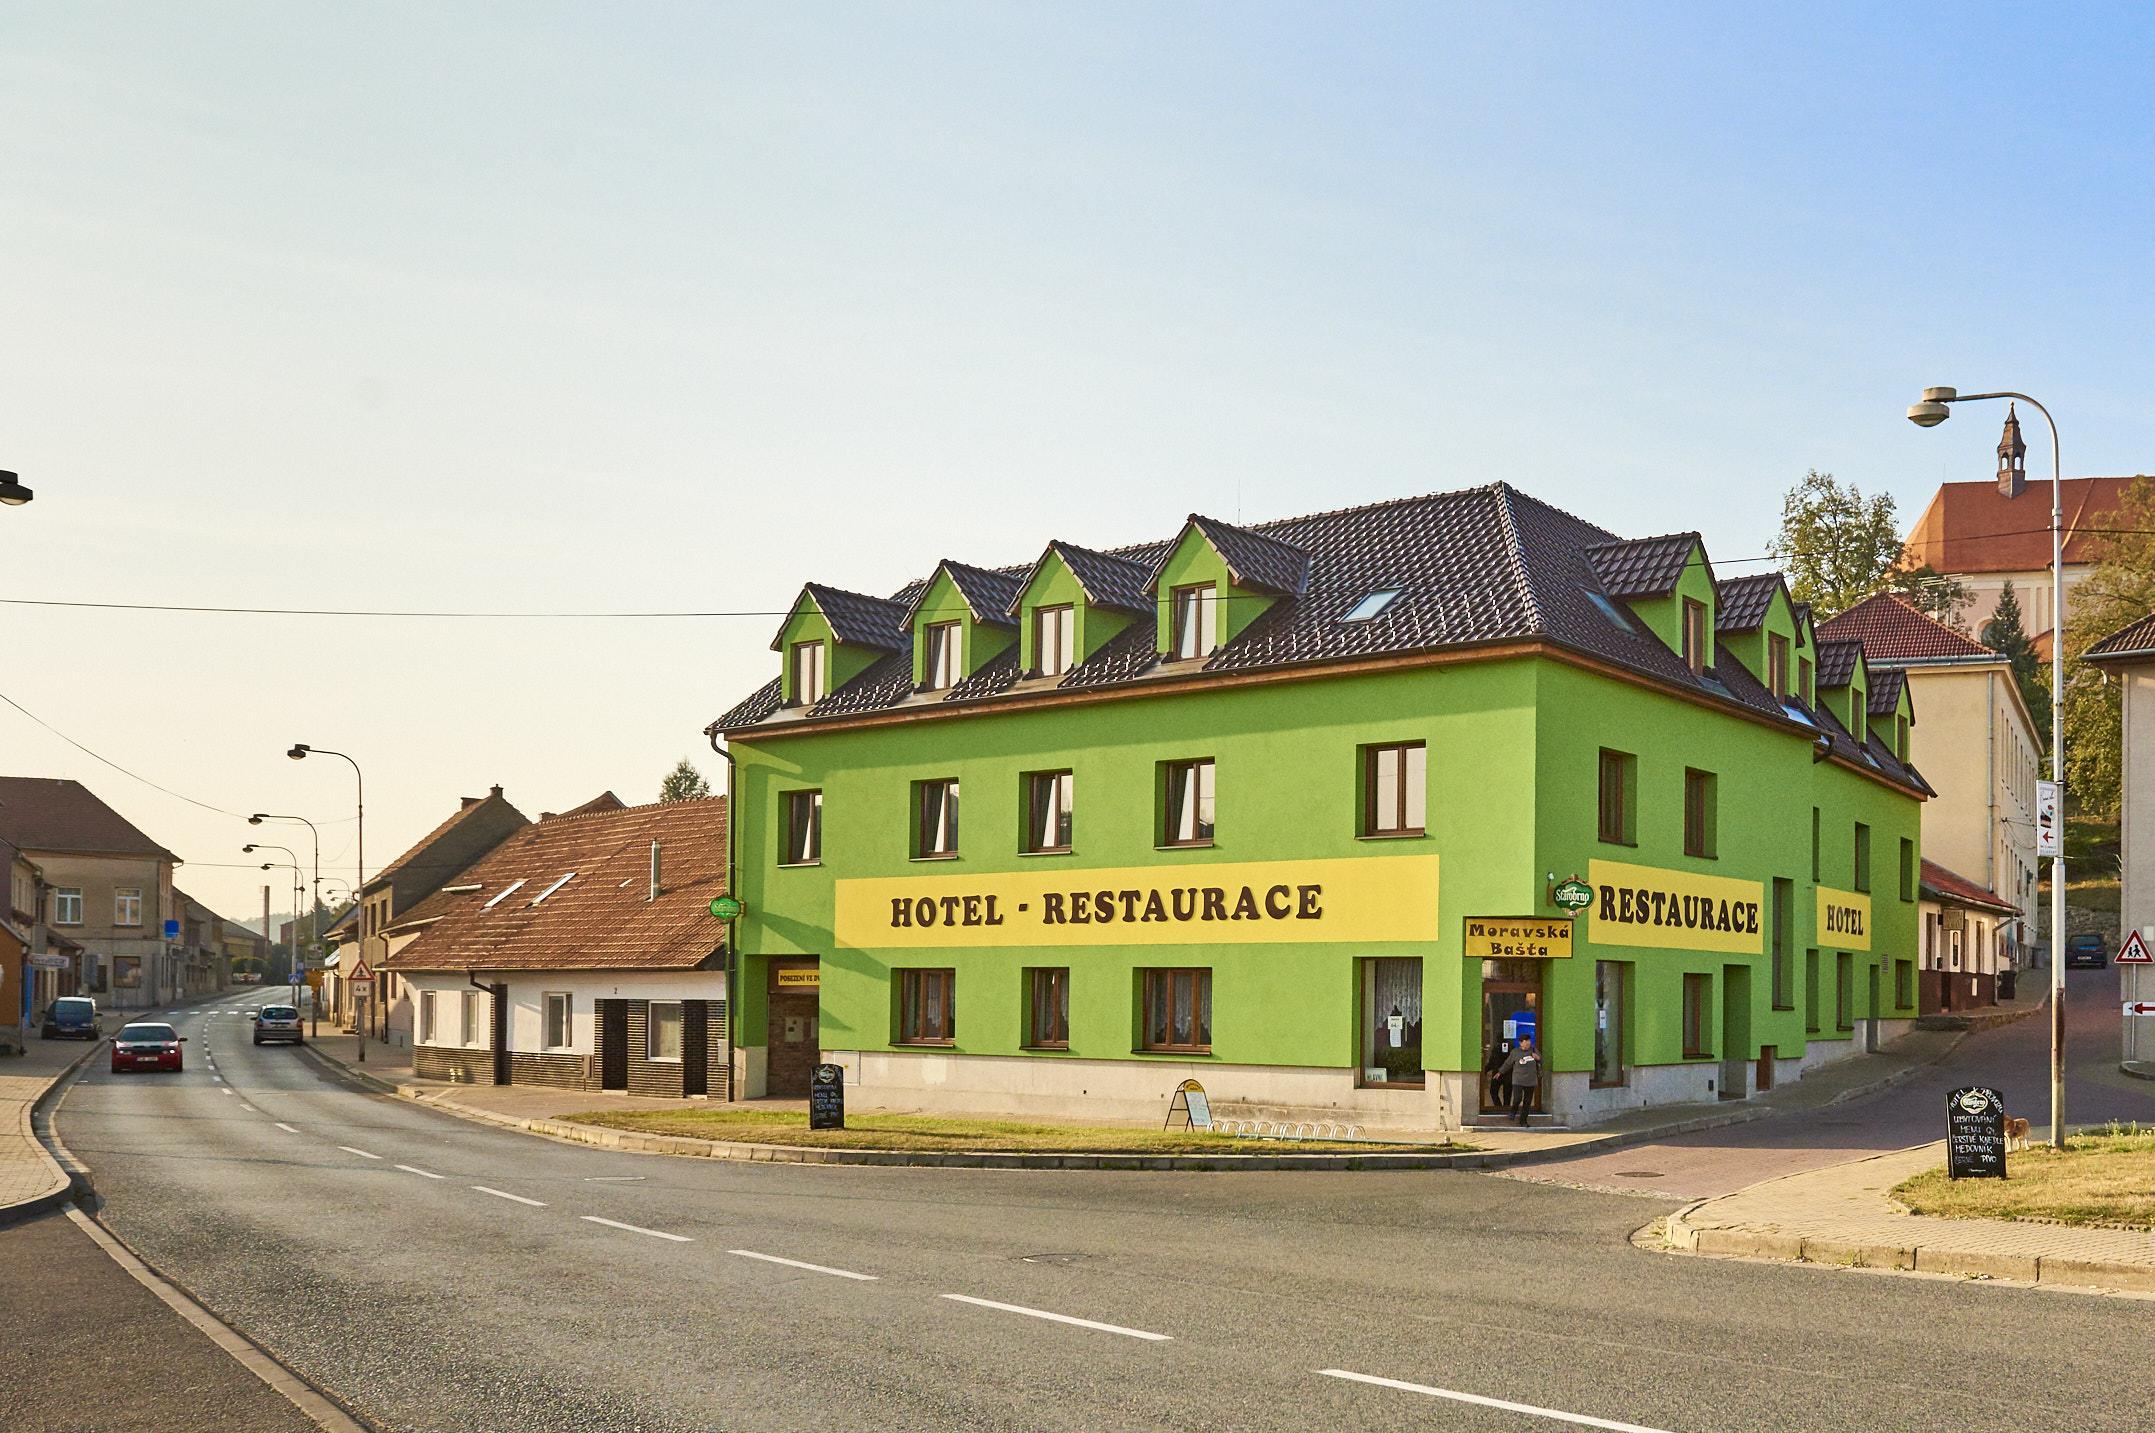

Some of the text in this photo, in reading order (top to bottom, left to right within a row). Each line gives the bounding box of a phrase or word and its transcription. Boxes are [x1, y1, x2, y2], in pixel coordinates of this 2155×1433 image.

[890, 895, 1003, 928] HOTEL
[1043, 885, 1323, 924] RESTAURACE
[1555, 886, 1590, 906] Starobrno
[1599, 885, 1759, 934] RESTAURACE
[1827, 904, 1863, 936] HOTEL
[1469, 923, 1569, 938] Moravská
[1490, 942, 1548, 956] Bašta
